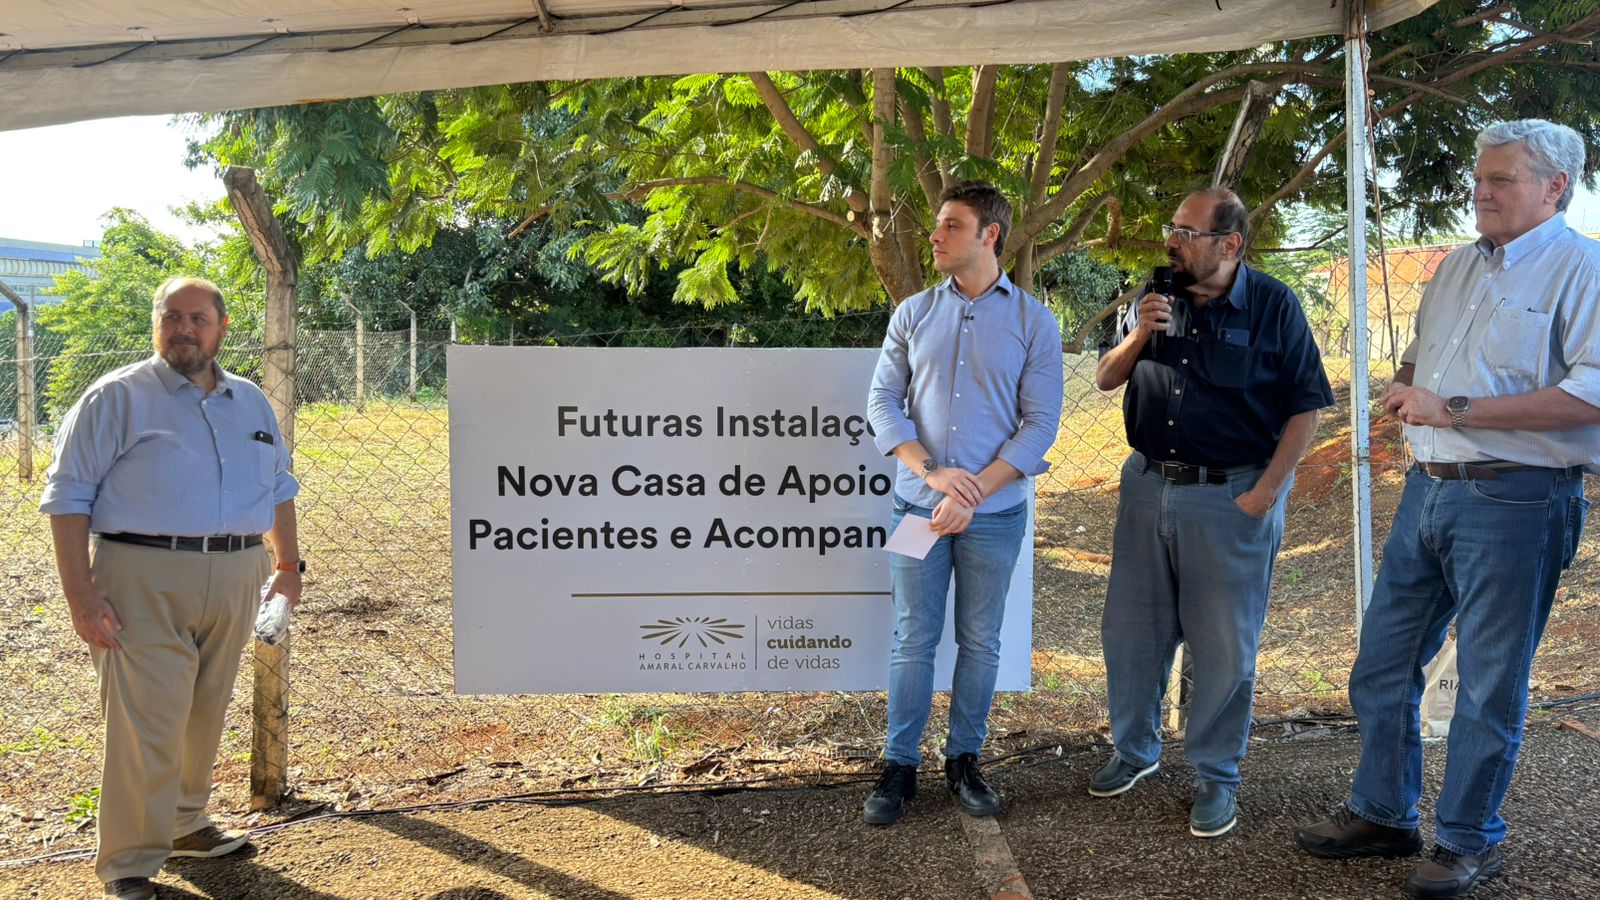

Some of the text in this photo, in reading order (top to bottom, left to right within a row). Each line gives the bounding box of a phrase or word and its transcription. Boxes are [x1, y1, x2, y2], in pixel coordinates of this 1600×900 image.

[557, 405, 703, 438] Futuras
[497, 464, 892, 504] Nova Casa de Apoio
[469, 517, 887, 556] Pacientes e Acompan
[767, 615, 814, 630] vidas
[766, 634, 853, 650] cuidando
[638, 652, 747, 660] HOSPITAL
[767, 654, 841, 670] de vidas
[639, 661, 747, 671] AMARAL CARVALHO
